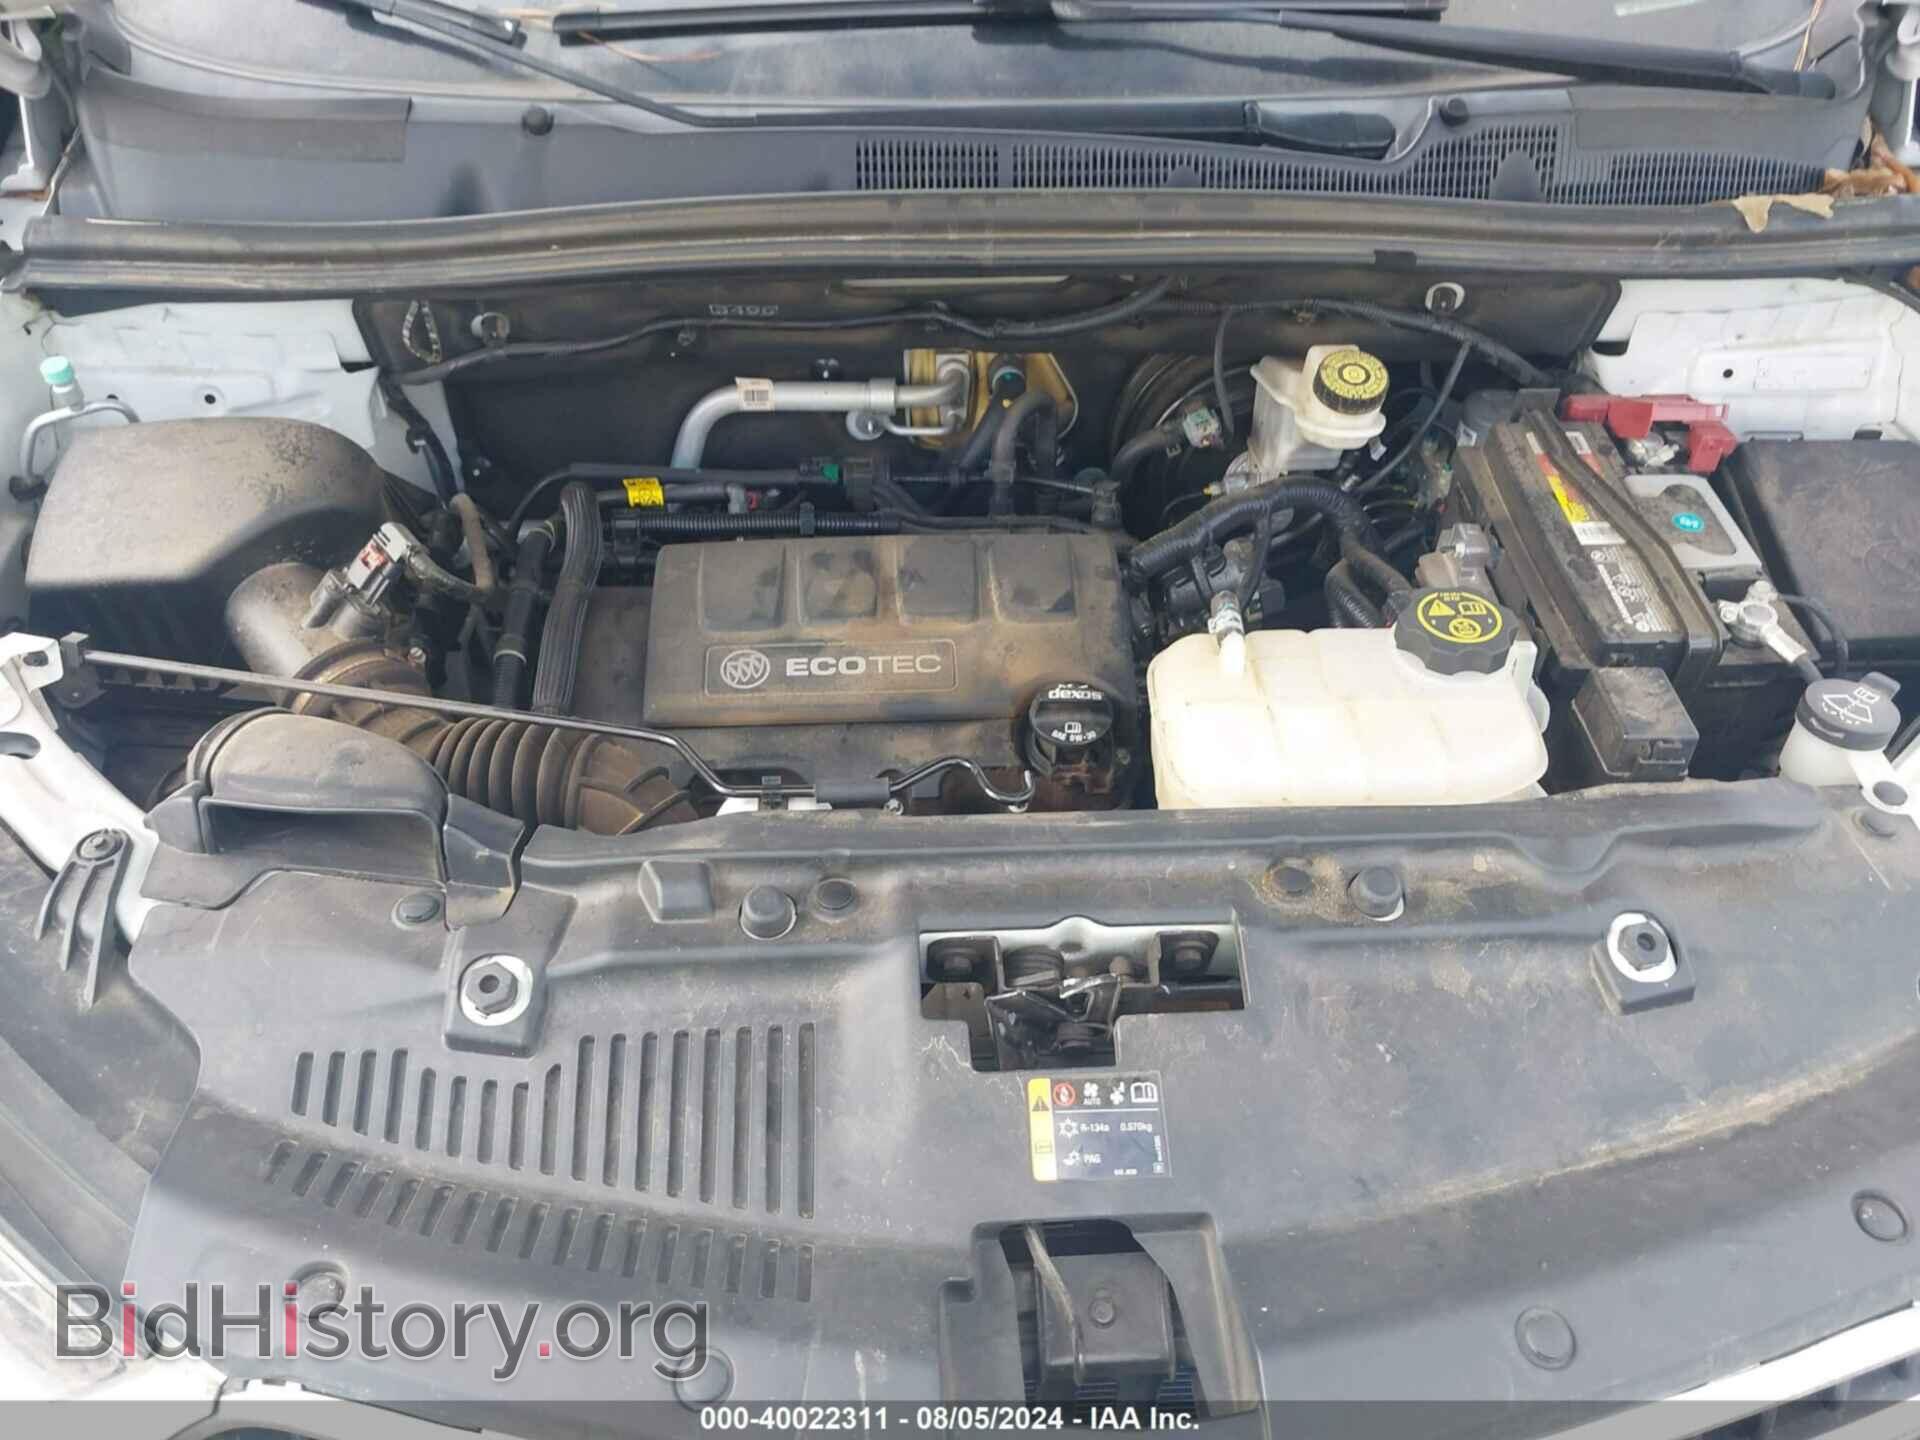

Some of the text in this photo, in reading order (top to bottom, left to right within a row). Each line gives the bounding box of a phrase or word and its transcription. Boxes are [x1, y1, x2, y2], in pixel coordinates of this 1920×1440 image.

[786, 655, 942, 676] ECOTEC
[1048, 687, 1102, 700] dexos
[1083, 1153, 1101, 1164] PAG
